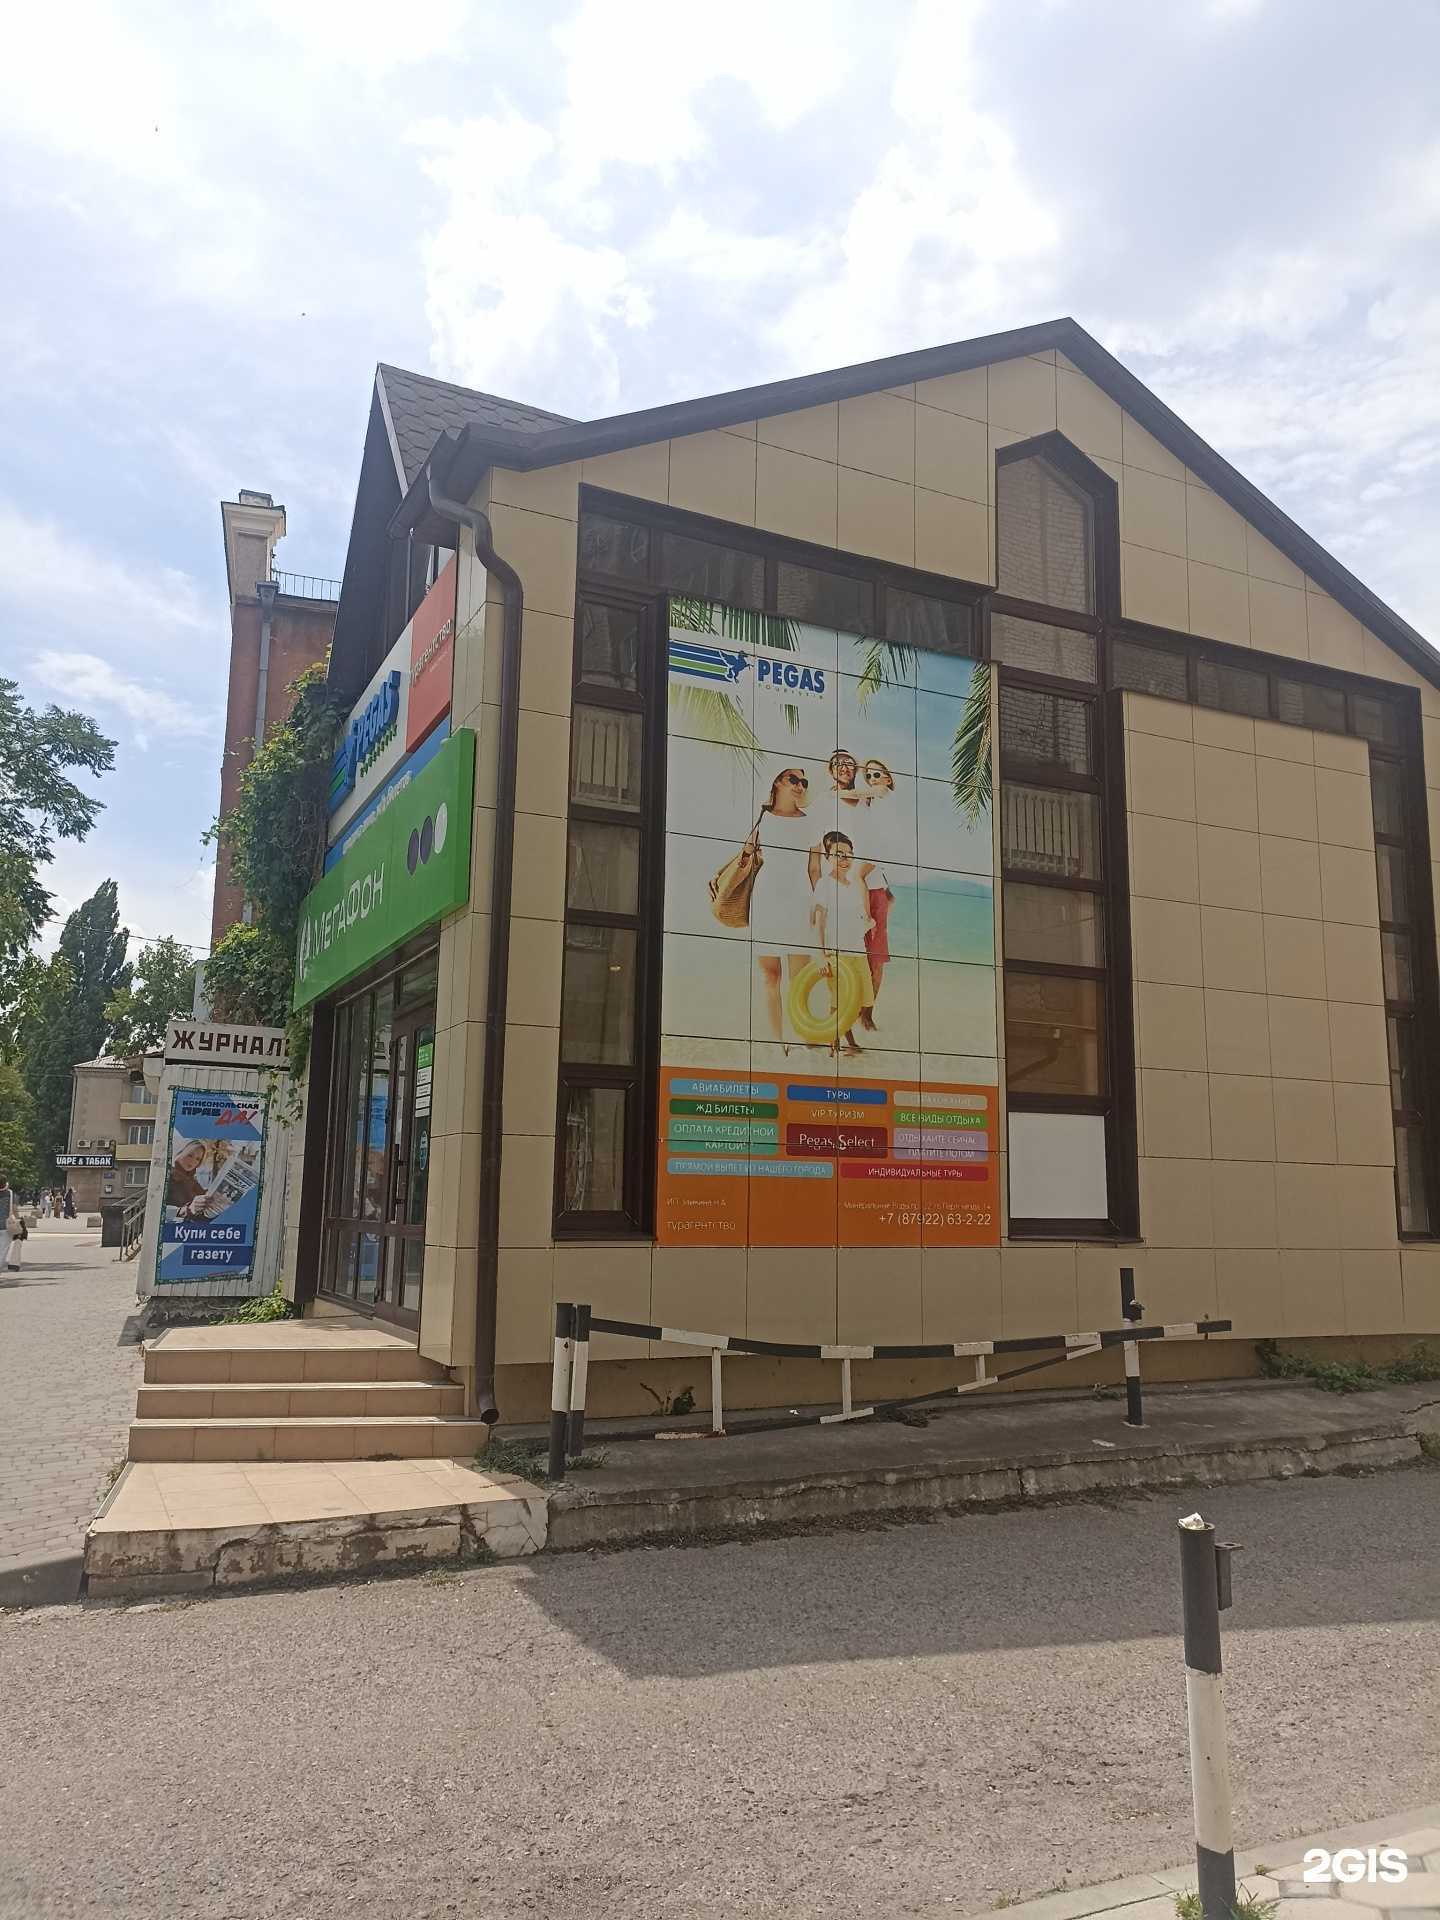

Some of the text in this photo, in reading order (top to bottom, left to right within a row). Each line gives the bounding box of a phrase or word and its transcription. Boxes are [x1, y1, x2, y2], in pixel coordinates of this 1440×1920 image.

[757, 659, 825, 694] PEGAS
[692, 1082, 759, 1095] АВИАБИЛЕТЫ
[826, 1090, 851, 1100] ТУРЫ
[182, 1100, 259, 1110] КОМСОМОЛЬСКАЯ
[696, 1103, 755, 1115] ЖД БИЛЕТЫ
[811, 1109, 865, 1120] VIP ТУРИЗМ
[900, 1112, 981, 1126] ВСЕ ВИДЫ ОТДЫХА
[838, 1134, 875, 1151] Select
[86, 1156, 112, 1166] ТАБАК
[868, 1168, 963, 1178] ИНДИВИДУАЛЬНЫЕ ТУРЫ
[879, 1213, 992, 1227] +7 (87922) 63-2-22
[174, 1226, 241, 1242] Купи себе
[190, 1249, 233, 1263] газету
